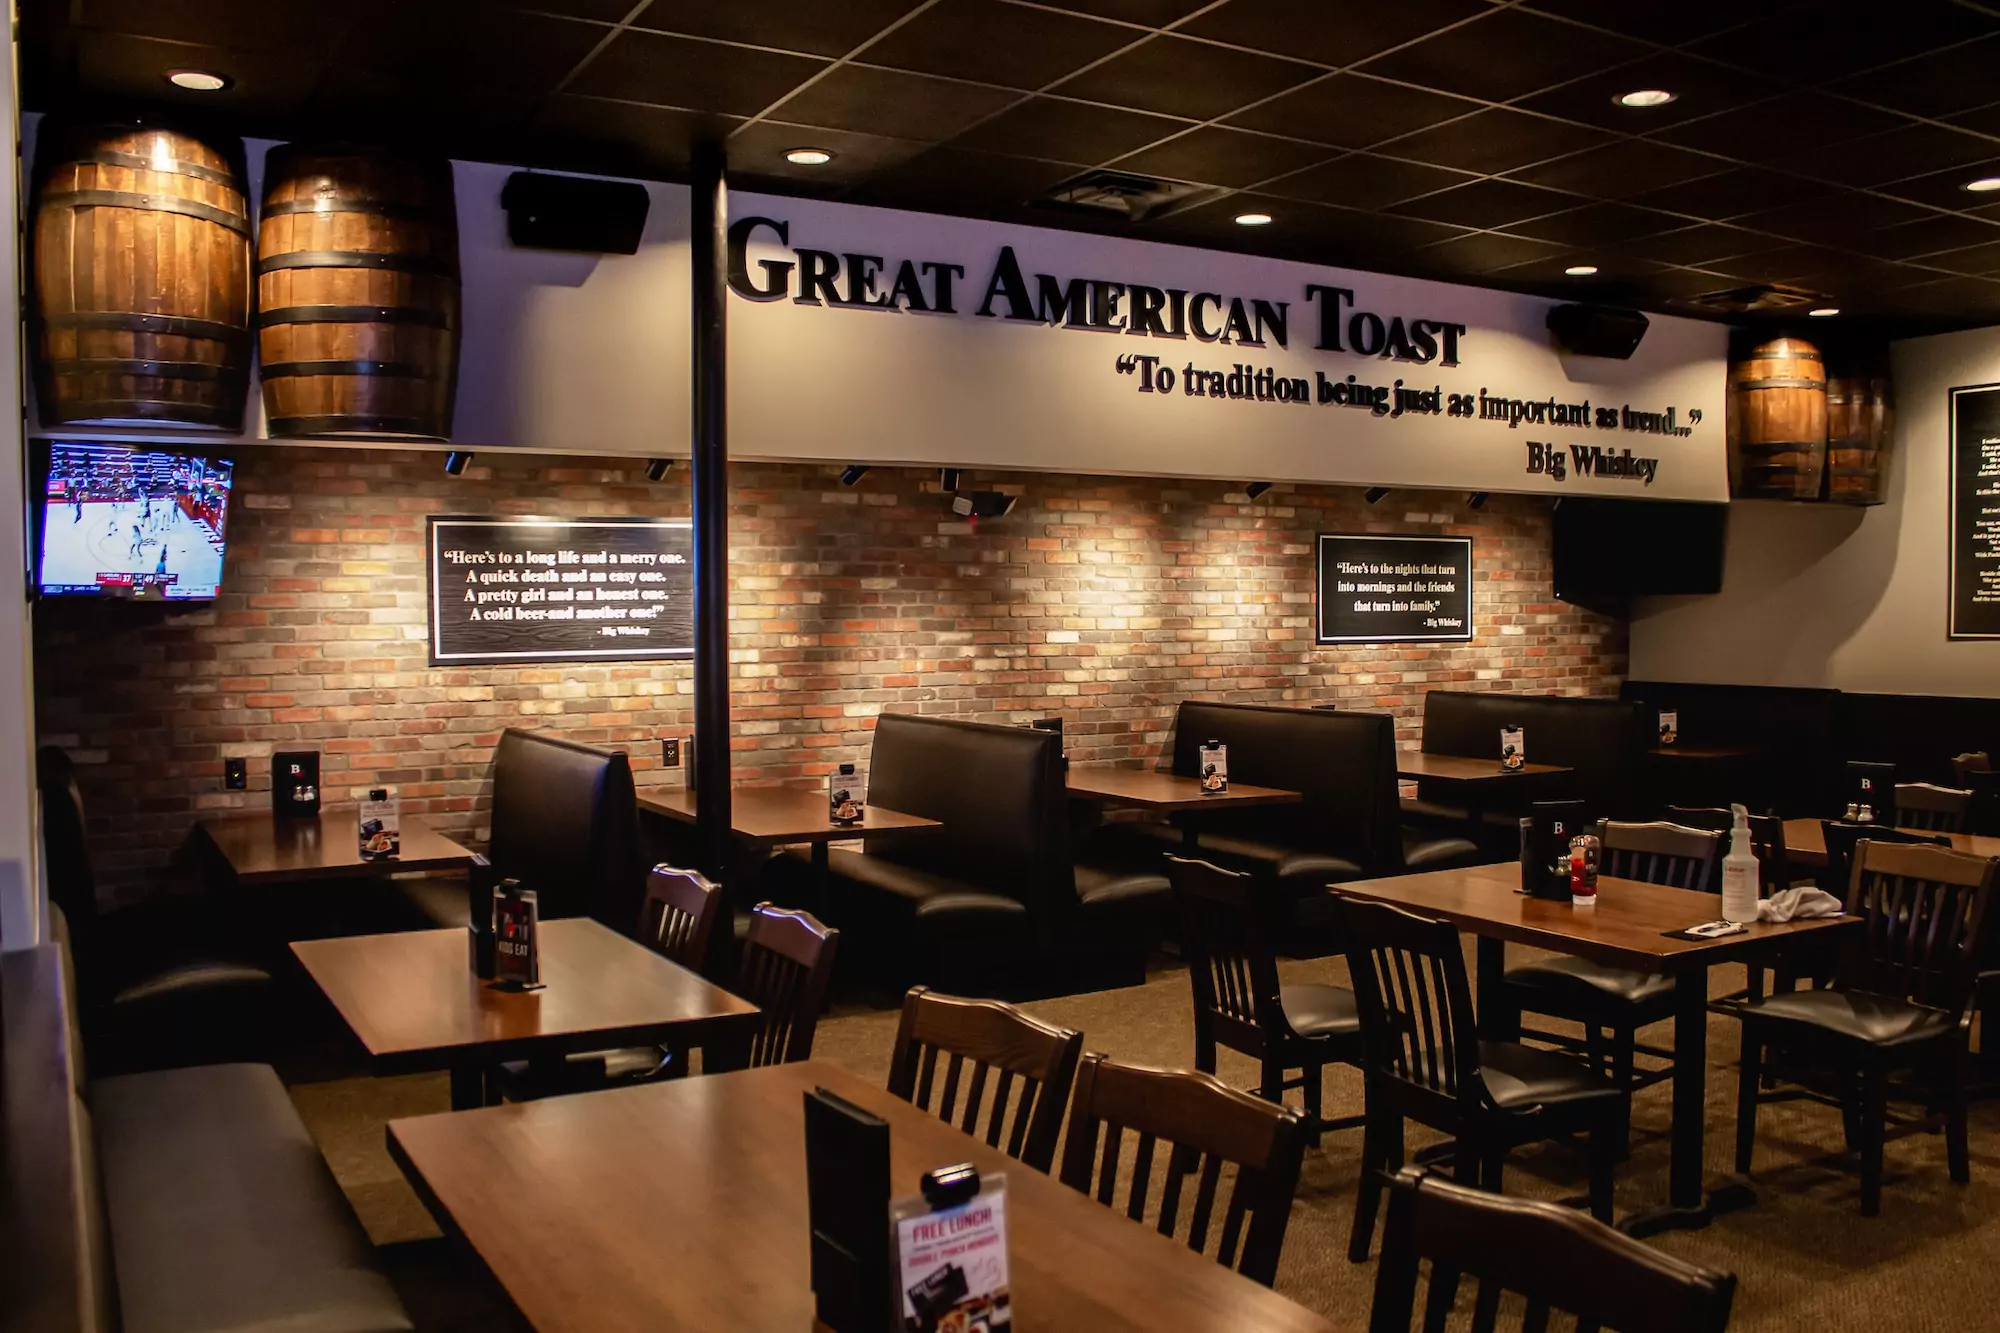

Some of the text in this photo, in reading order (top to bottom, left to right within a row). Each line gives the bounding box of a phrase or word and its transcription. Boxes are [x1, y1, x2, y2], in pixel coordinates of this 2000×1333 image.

[727, 216, 1465, 367] GREAT AMERICAN TOAST
[1116, 353, 1175, 394] “To
[1183, 362, 1311, 404] tradition
[1315, 371, 1390, 418] being
[1391, 379, 1442, 418] just
[1447, 392, 1474, 418] as
[1479, 387, 1591, 428] important
[1595, 405, 1619, 430] as
[1526, 441, 1658, 487] Big Whiskey
[444, 550, 686, 566] “Here’s to a long life and a merry one.
[1337, 562, 1455, 576] “Here’s to the nights that turn
[466, 569, 667, 585] A quick death and an easy one.
[1337, 580, 1455, 594] into mornings and the friends
[464, 588, 669, 604] A pretty girl and an honest one.
[470, 608, 481, 620] A
[484, 607, 512, 620] cold
[576, 606, 626, 619] another
[1354, 600, 1440, 613] that turn into family.”
[1438, 618, 1462, 628] Whiskey
[1861, 778, 1870, 789] B
[1554, 822, 1563, 834] B
[515, 944, 528, 956] EAT
[913, 1221, 946, 1243] FREE
[950, 1207, 992, 1233] LUNCH!
